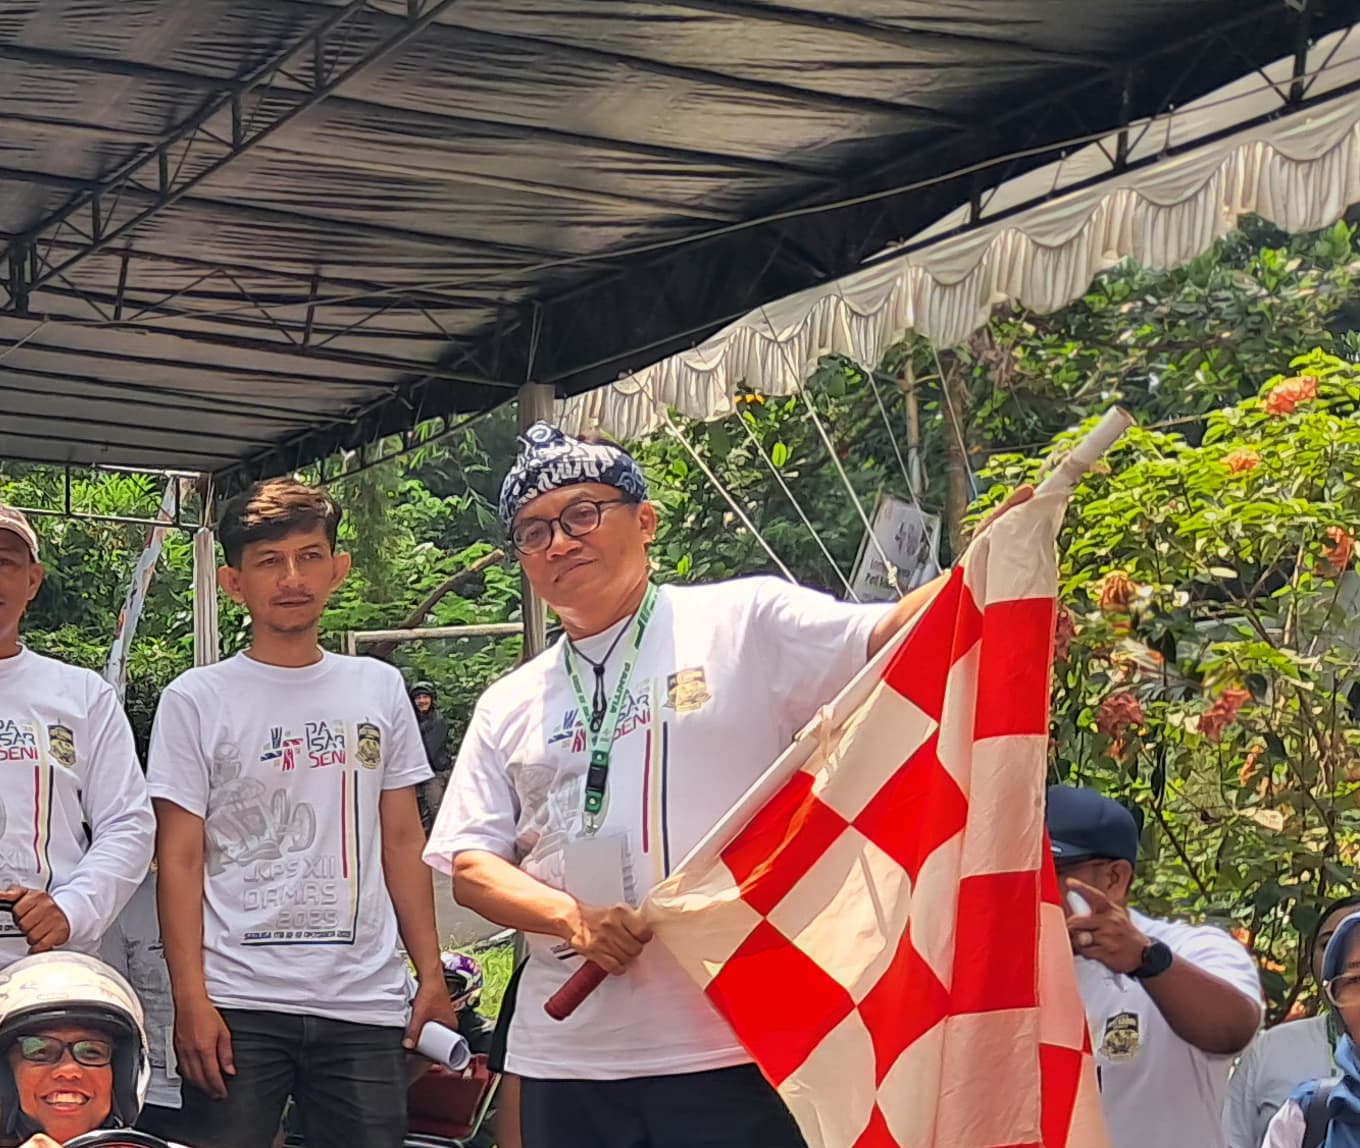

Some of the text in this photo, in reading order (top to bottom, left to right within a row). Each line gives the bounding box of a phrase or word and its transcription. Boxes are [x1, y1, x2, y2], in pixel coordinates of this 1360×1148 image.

[305, 721, 329, 750] PA
[311, 735, 345, 752] SAR
[309, 750, 346, 768] SENI
[302, 856, 336, 879] XII
[243, 881, 337, 912] DAMAS
[275, 909, 338, 930] 2025
